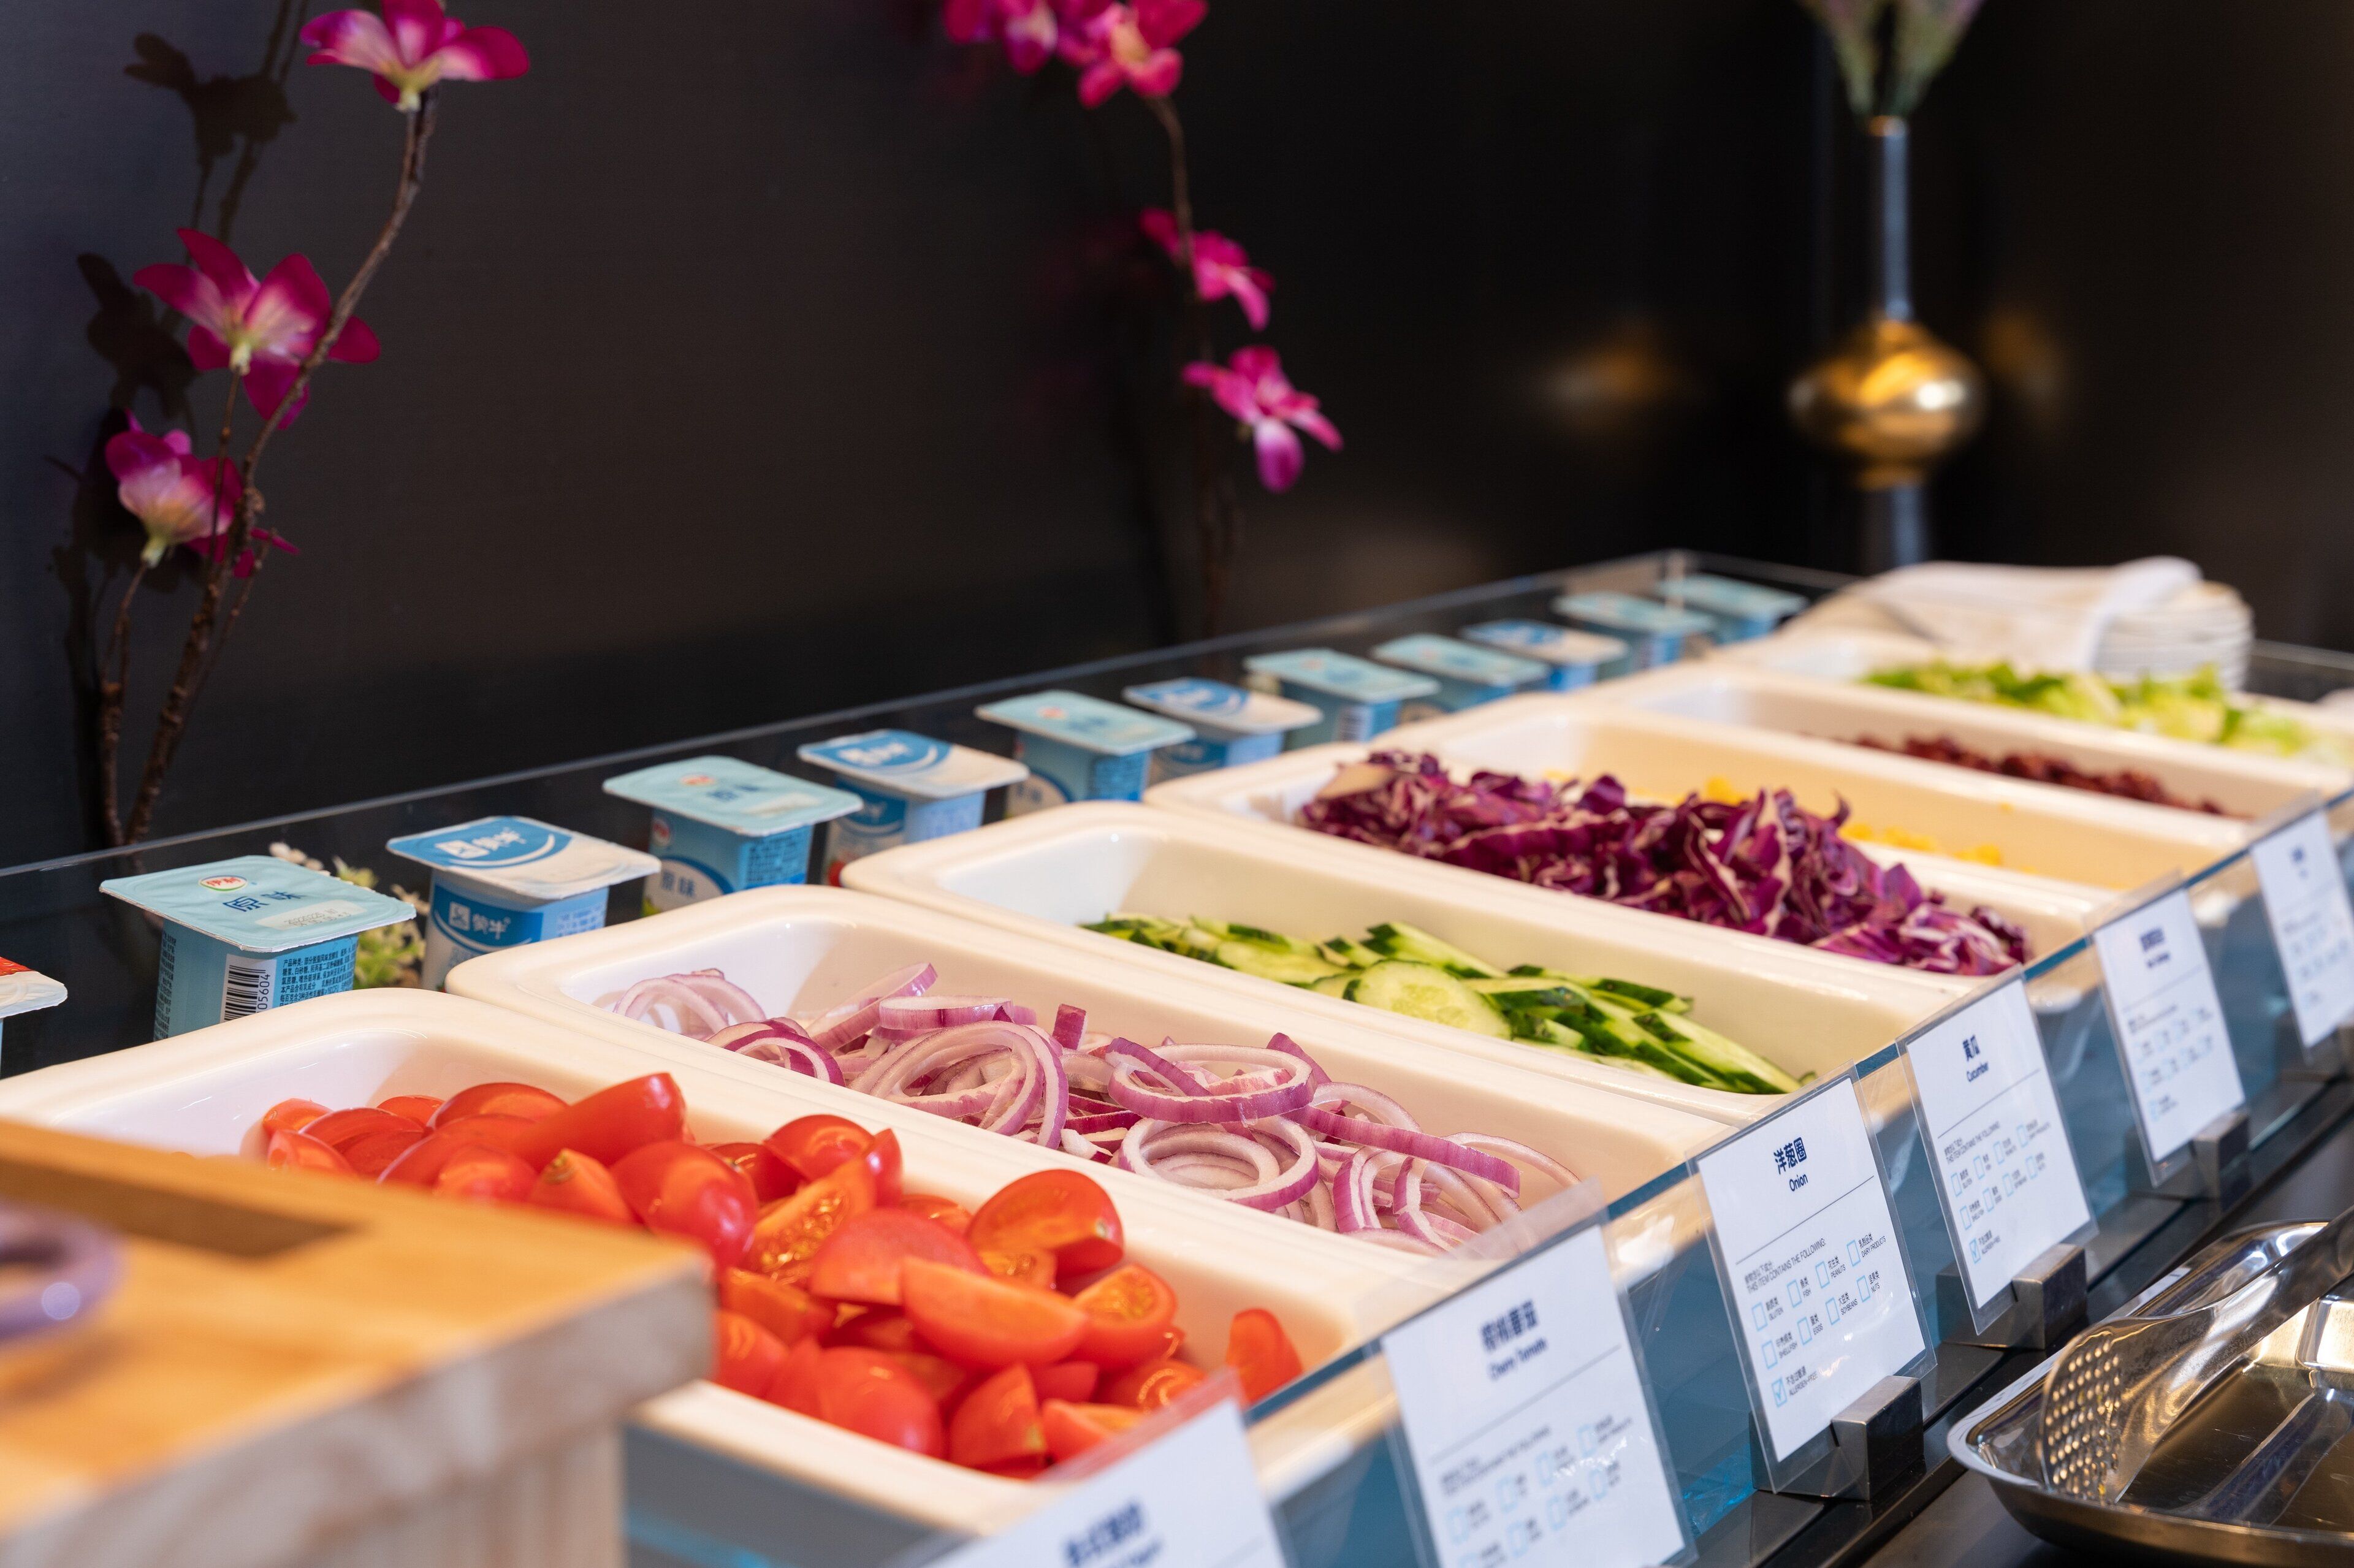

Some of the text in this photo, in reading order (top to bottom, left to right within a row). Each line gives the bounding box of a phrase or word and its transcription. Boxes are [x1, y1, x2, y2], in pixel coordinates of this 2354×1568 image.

[1773, 1137, 1807, 1174] 洋葱圈
[1789, 1174, 1808, 1192] Onion
[1861, 1236, 1886, 1258] DAIRY PRODUCTS
[1769, 1260, 1792, 1281] CONTAINS
[1791, 1254, 1801, 1266] THE
[1827, 1255, 1840, 1269] 花生类
[1830, 1264, 1846, 1279] PEANUTS
[1871, 1282, 1880, 1293] NUTS
[1838, 1292, 1850, 1306] 大豆类
[1840, 1298, 1858, 1315] SOYBEANS
